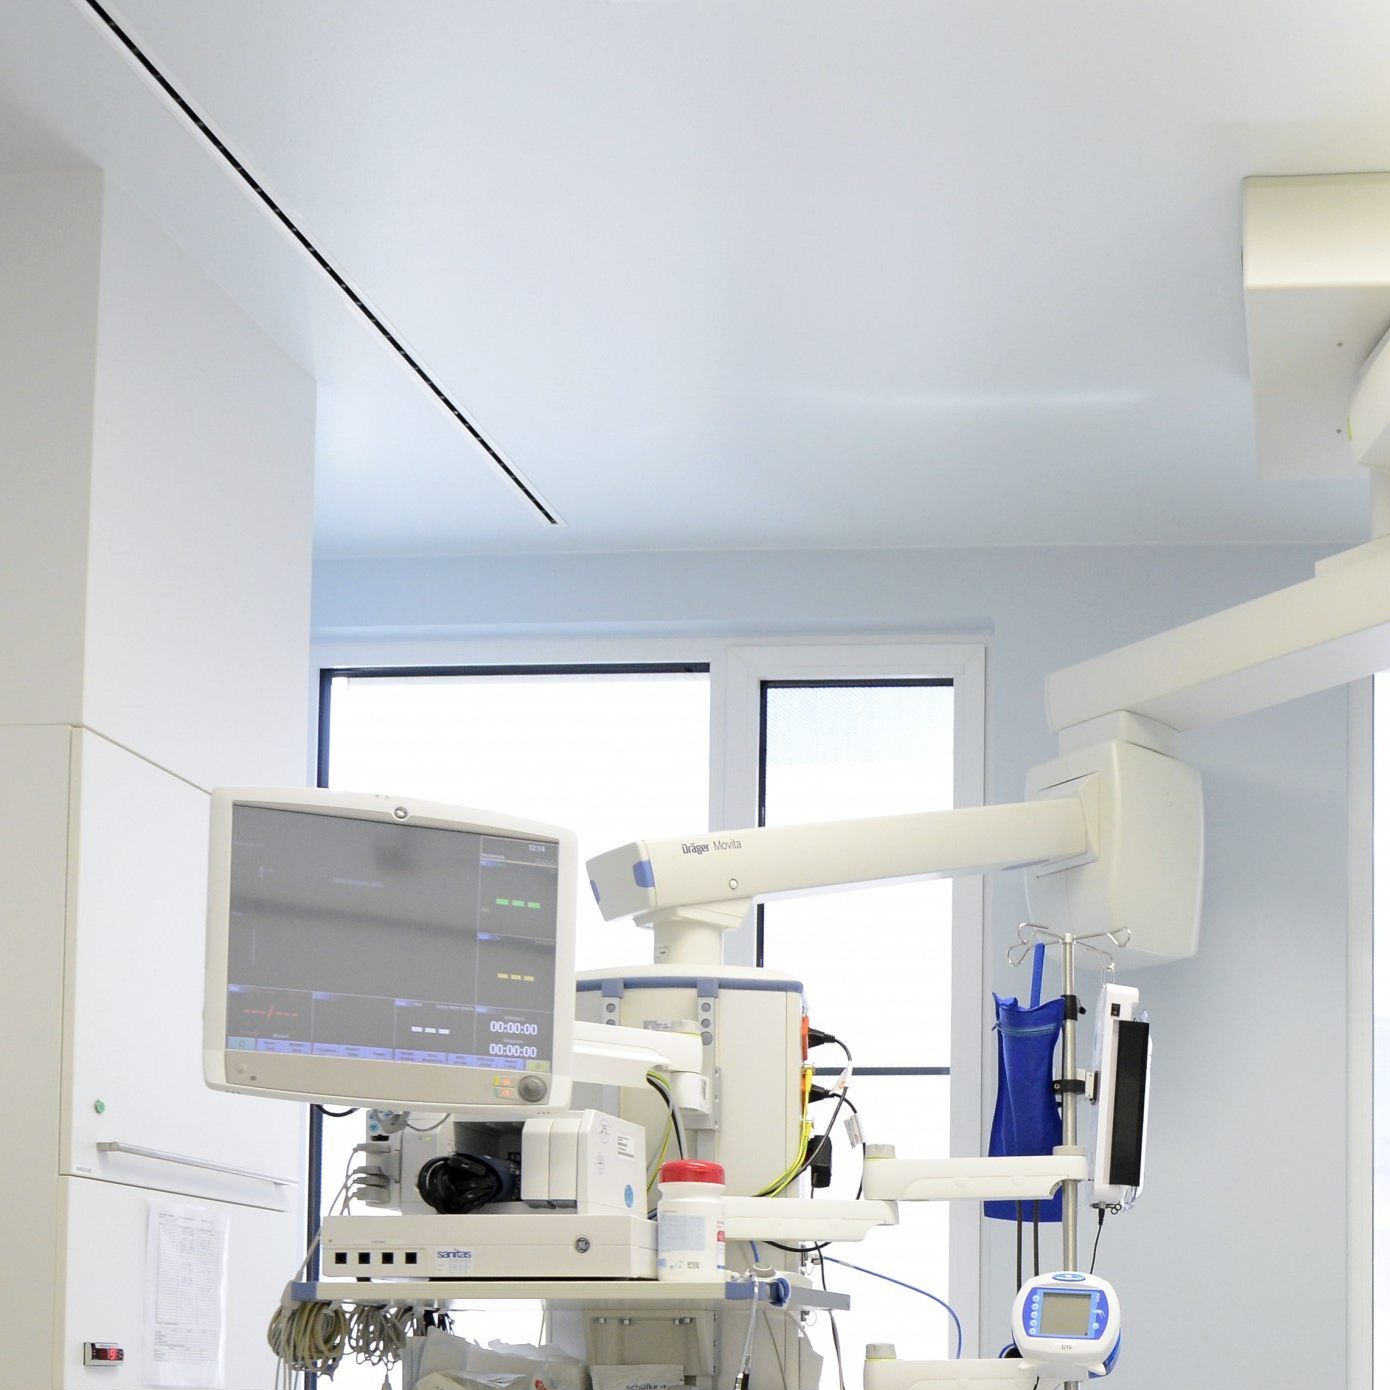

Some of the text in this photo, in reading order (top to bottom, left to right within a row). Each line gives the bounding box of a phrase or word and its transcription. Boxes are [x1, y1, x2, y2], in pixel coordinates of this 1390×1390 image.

[681, 840, 742, 855] Dräger Movita
[490, 1021, 538, 1035] 00:00:00
[489, 1043, 537, 1057] 00:00:00
[437, 1249, 472, 1259] sanitas
[625, 1383, 658, 1390] schülke
